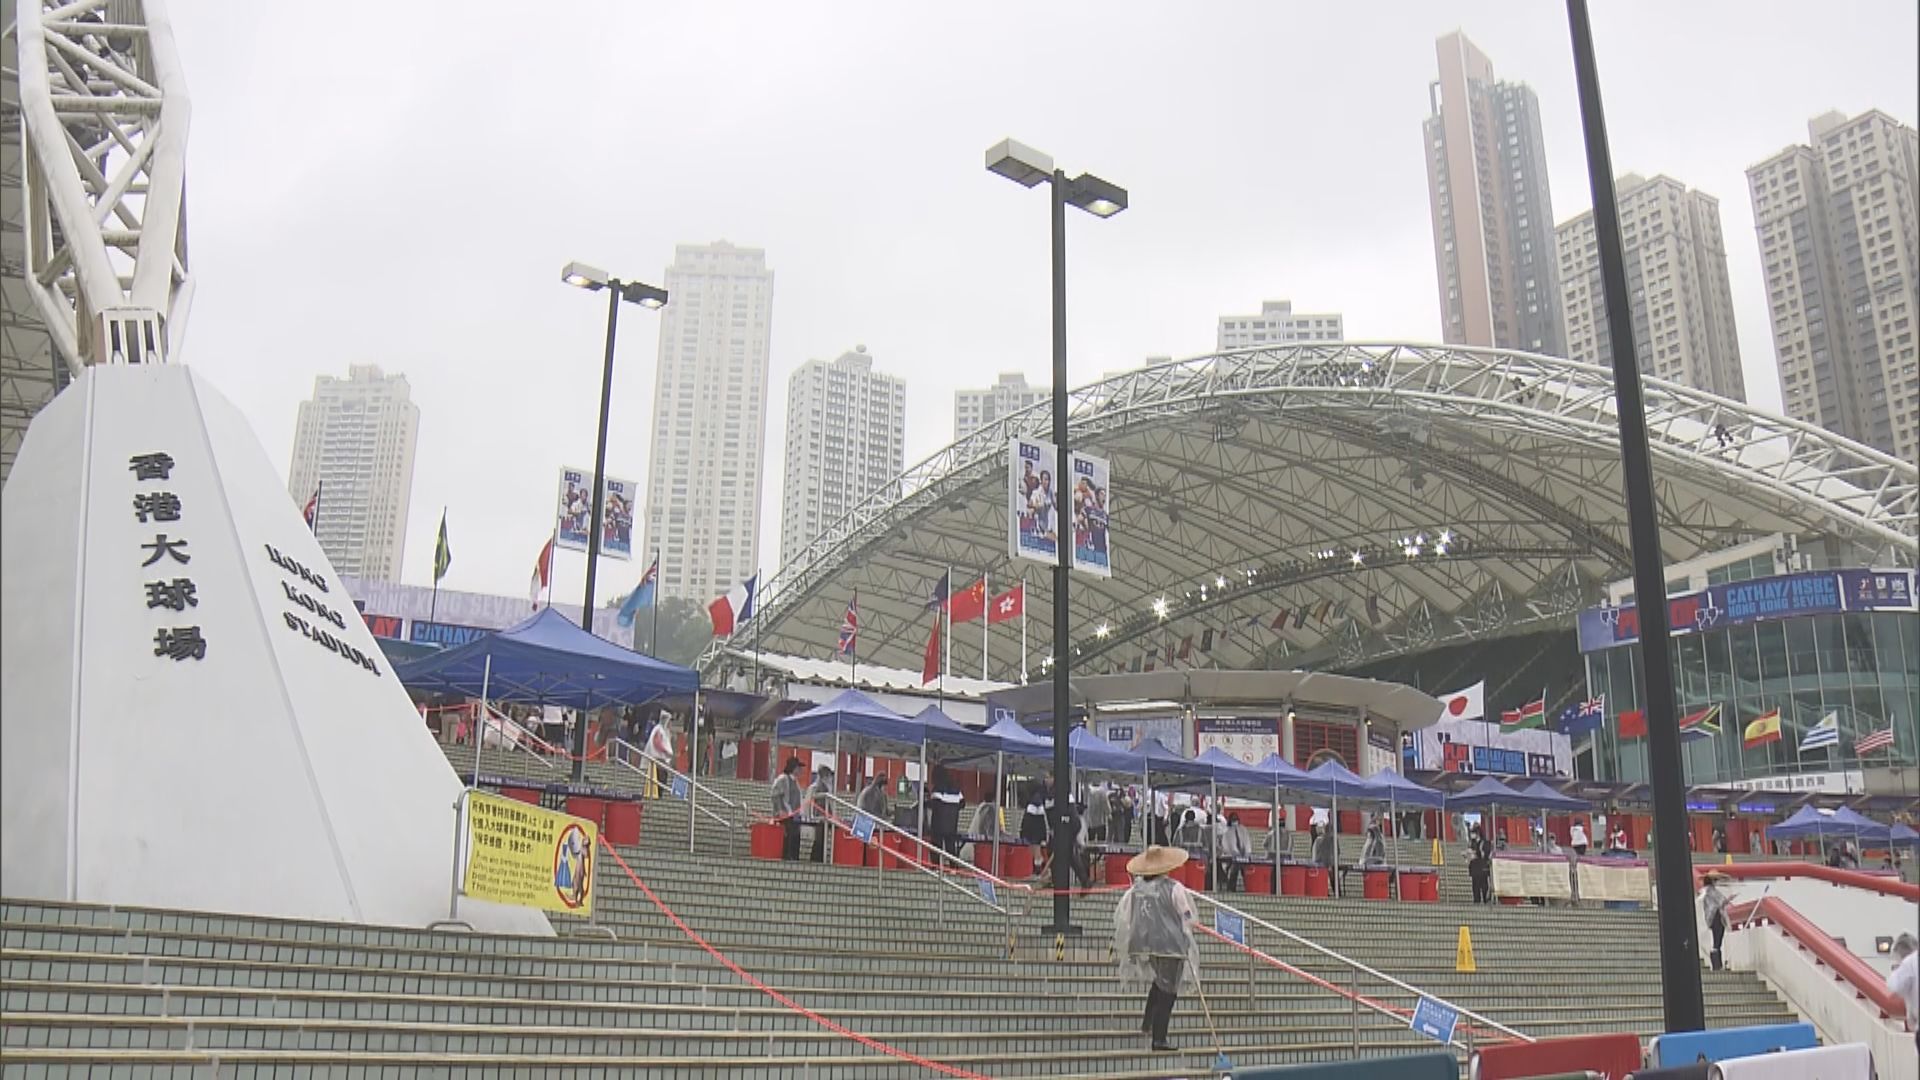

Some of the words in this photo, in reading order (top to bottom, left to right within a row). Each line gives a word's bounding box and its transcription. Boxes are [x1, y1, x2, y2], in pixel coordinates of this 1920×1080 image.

[129, 452, 207, 661] 香港大球場
[264, 543, 329, 593] HONG
[281, 579, 346, 629] KONG
[1726, 576, 1834, 603] CATHAY/HSBC
[1728, 602, 1756, 617] HONG
[1759, 598, 1788, 611] KONG
[1792, 594, 1836, 608] SEVENS
[283, 611, 381, 677] STADIUM
[414, 622, 486, 645] CATHAY/
